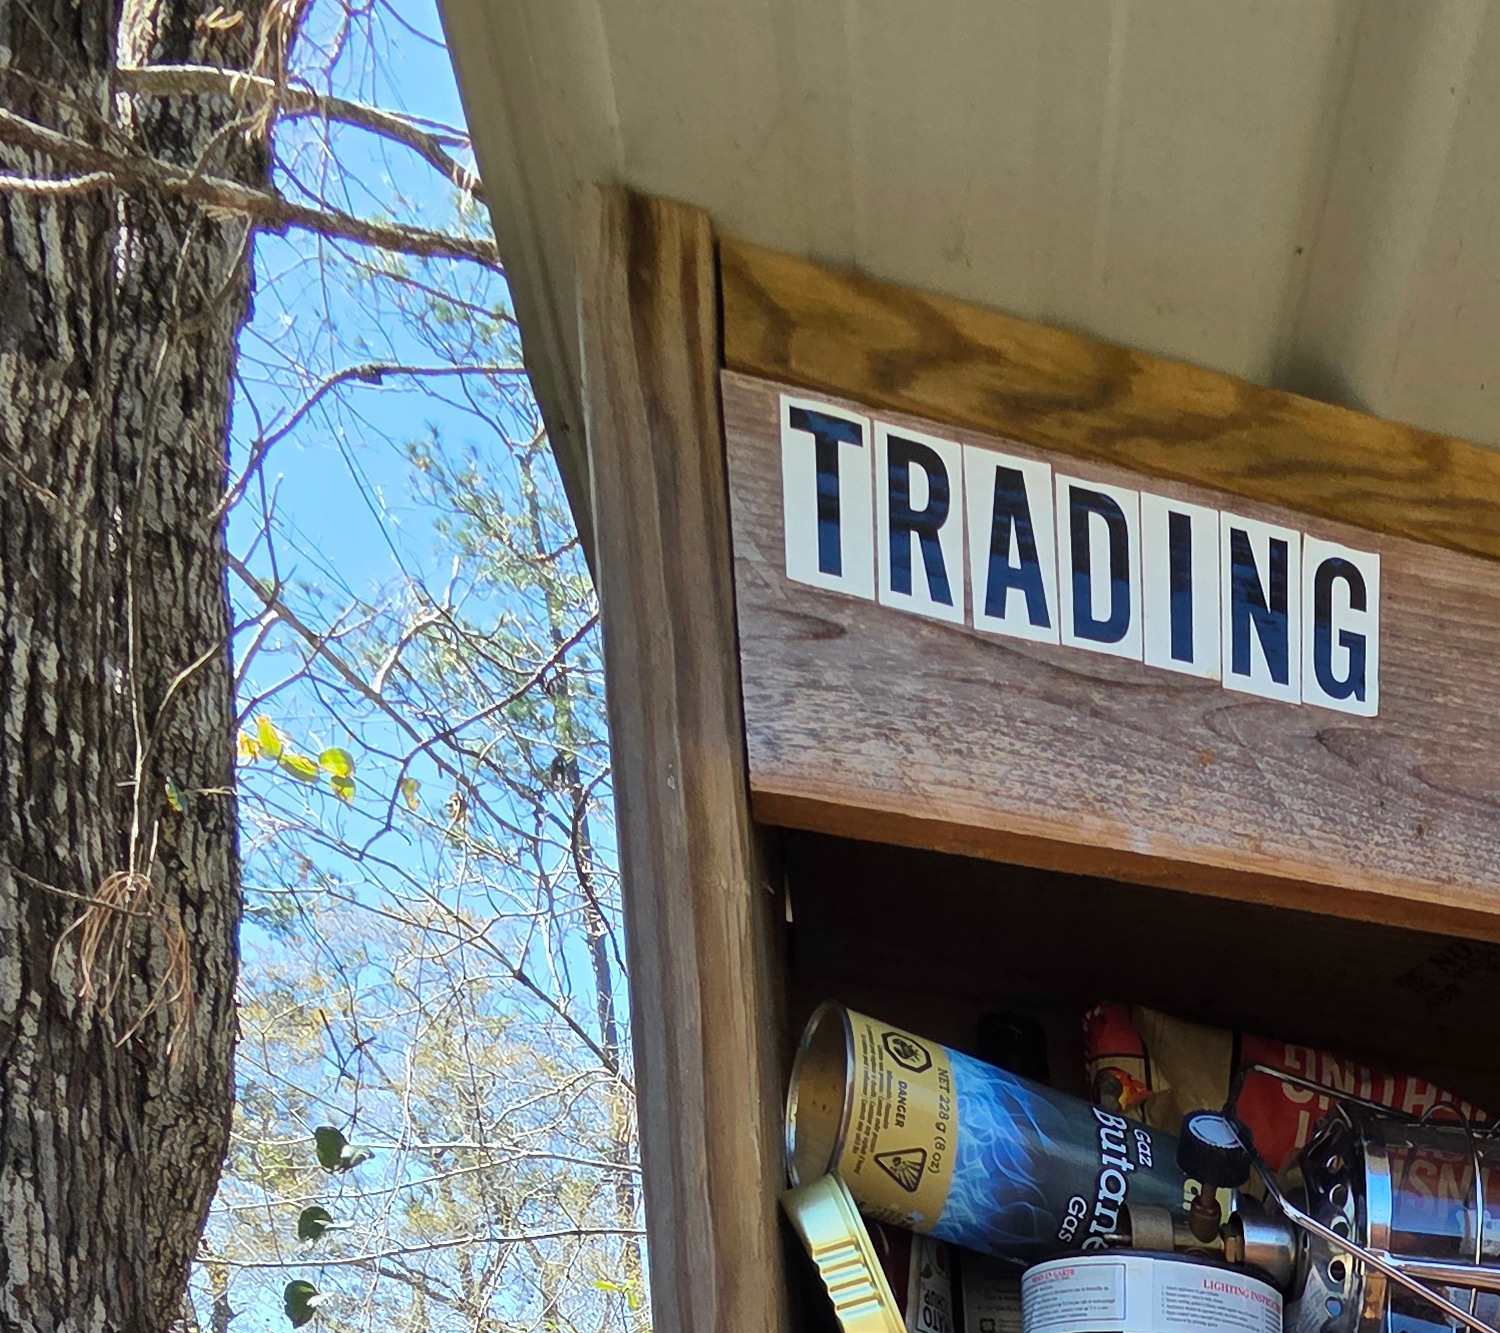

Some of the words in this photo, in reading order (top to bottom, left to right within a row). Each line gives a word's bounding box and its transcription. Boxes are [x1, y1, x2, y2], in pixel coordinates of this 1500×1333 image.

[788, 404, 1368, 703] TRADING
[937, 1067, 950, 1096] NET
[894, 1079, 908, 1129] DANGER
[938, 1094, 950, 1121] 228
[1133, 1128, 1153, 1168] Gaz
[1081, 1106, 1135, 1250] Butane
[1058, 1196, 1088, 1242] Gas
[1203, 1279, 1250, 1299] LIGHTING
